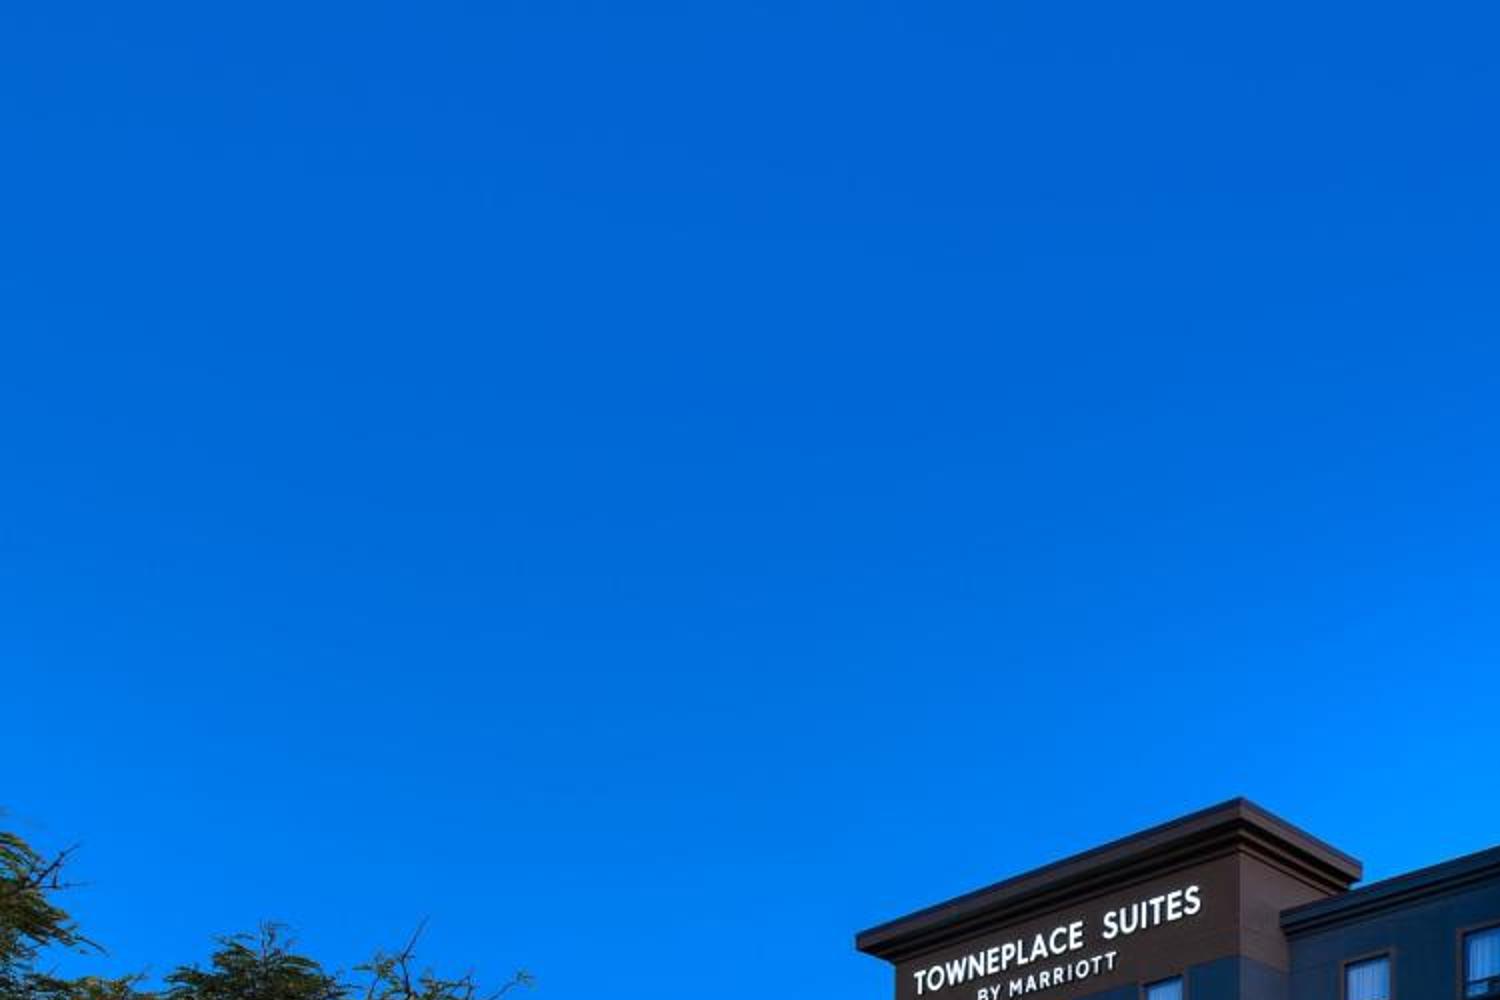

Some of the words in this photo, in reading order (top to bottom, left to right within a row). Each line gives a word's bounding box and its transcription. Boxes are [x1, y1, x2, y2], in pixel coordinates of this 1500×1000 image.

[913, 920, 1084, 995] TOWNEPLACE
[1102, 884, 1201, 940] SUITES
[1009, 950, 1117, 998] MARRIOTT
